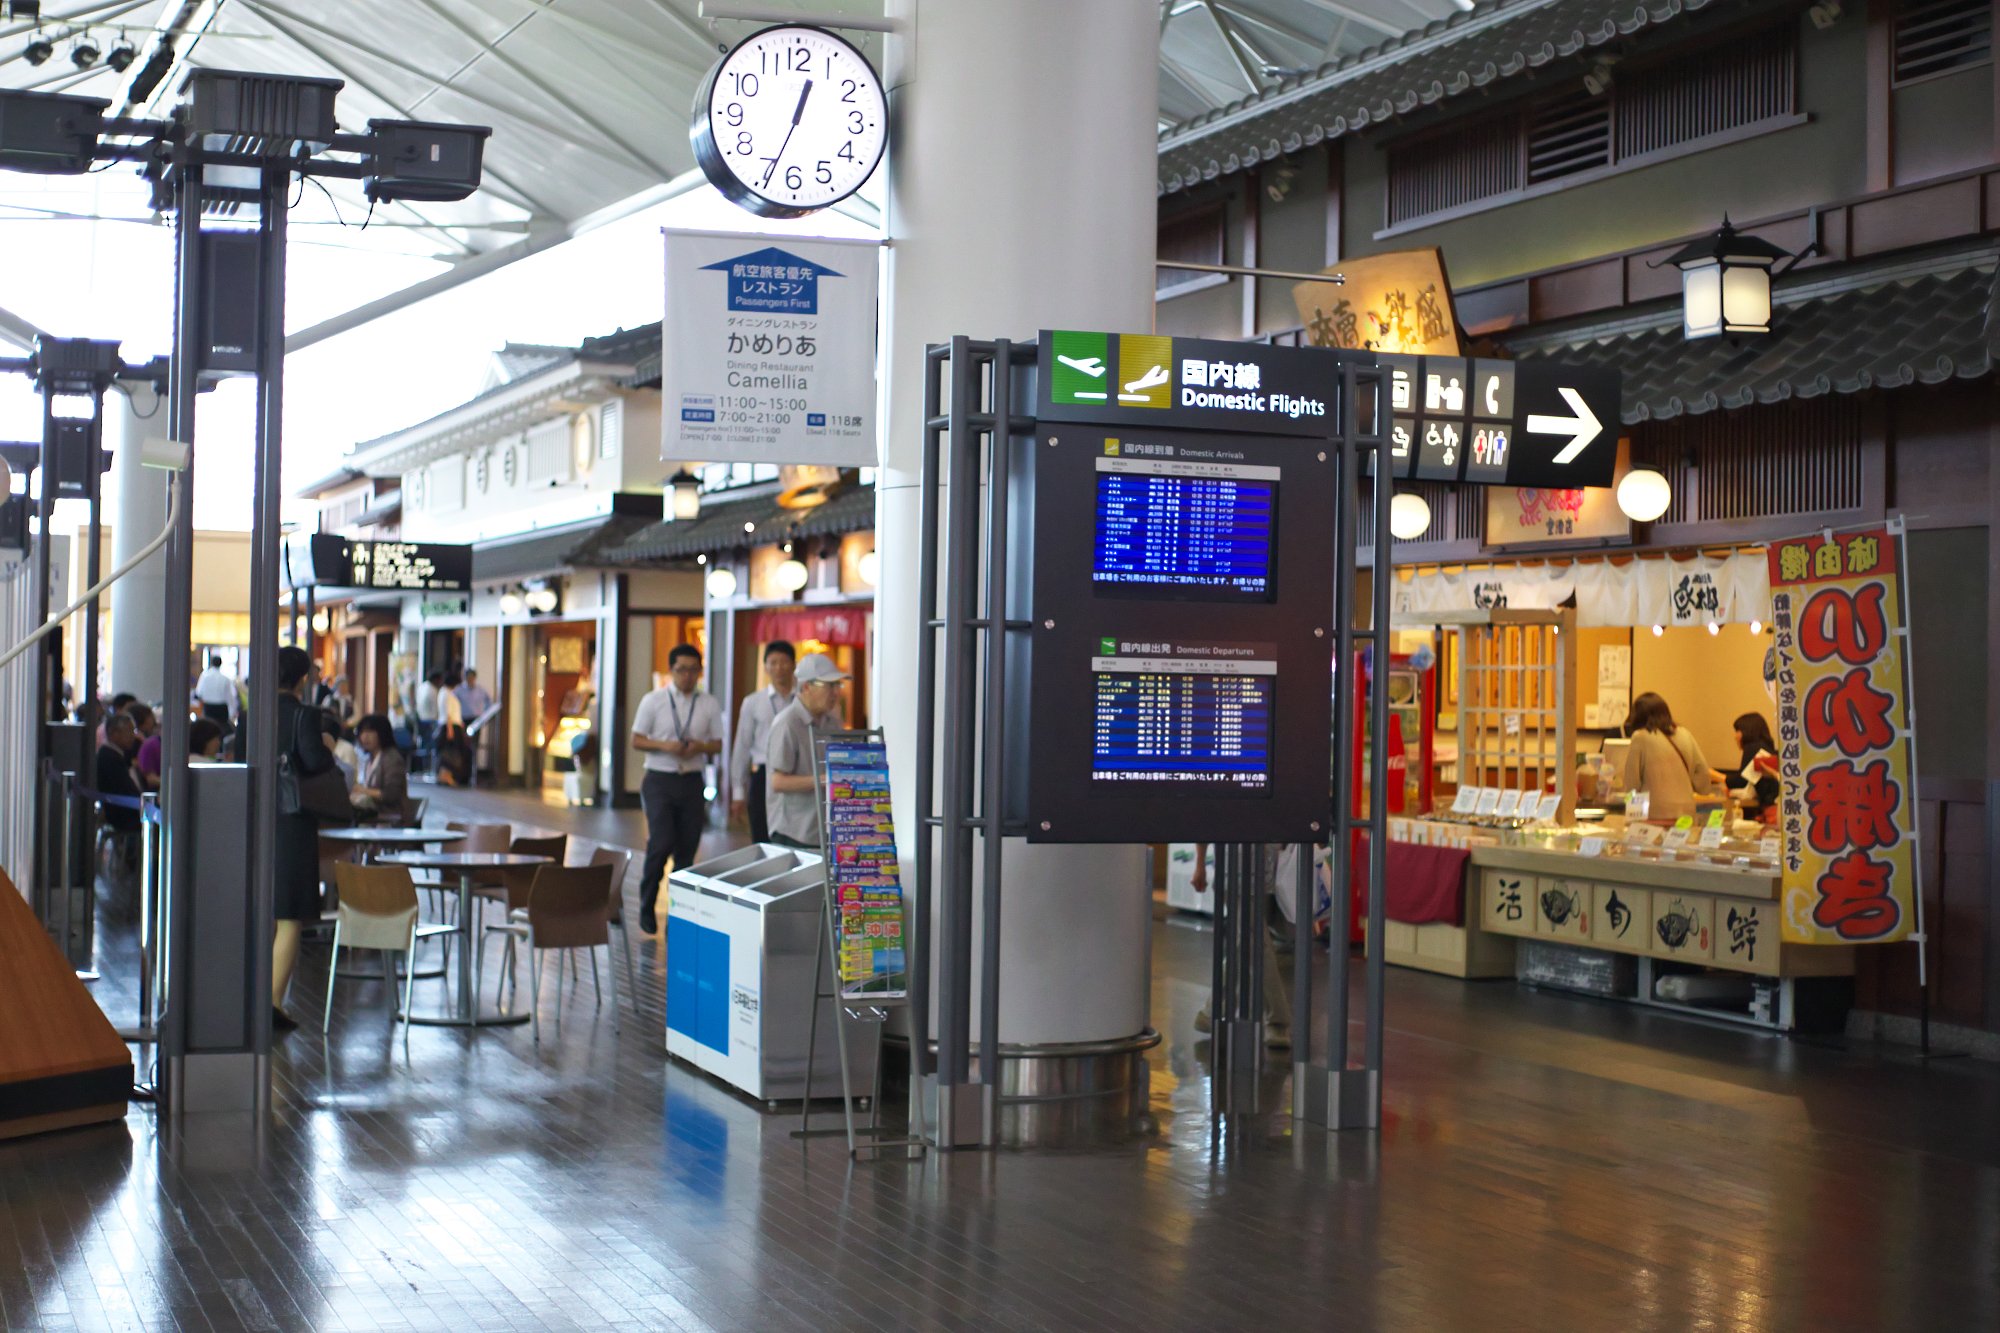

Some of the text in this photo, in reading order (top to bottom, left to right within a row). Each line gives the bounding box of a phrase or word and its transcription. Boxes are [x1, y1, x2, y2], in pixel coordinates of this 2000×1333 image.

[787, 47, 812, 73] 12
[735, 72, 759, 98] 10
[840, 79, 857, 103] 2
[726, 102, 744, 127] 9
[847, 110, 865, 135] 3
[736, 131, 753, 156] 8
[837, 140, 855, 163] 4
[759, 157, 778, 181] 7
[785, 165, 803, 190] 6
[815, 160, 833, 184] 5
[732, 263, 814, 282] 航空旅客優先
[742, 281, 804, 296] レストラン
[735, 296, 811, 309] Passengers First
[727, 317, 818, 331] ダイニングレストラン
[727, 332, 817, 357] かめりあ
[727, 360, 814, 373] Dining Restaurant
[1181, 358, 1260, 390] 国内線
[727, 371, 808, 390] Camellia
[1181, 390, 1325, 418] Domestic Flights
[1124, 443, 1175, 457] 国内線到着
[1180, 447, 1245, 460] Domestic Arrivals
[1120, 641, 1172, 655] 国内線出発
[1176, 645, 1255, 657] Domestic Departures
[1496, 878, 1760, 962] 活 旬 鮮
